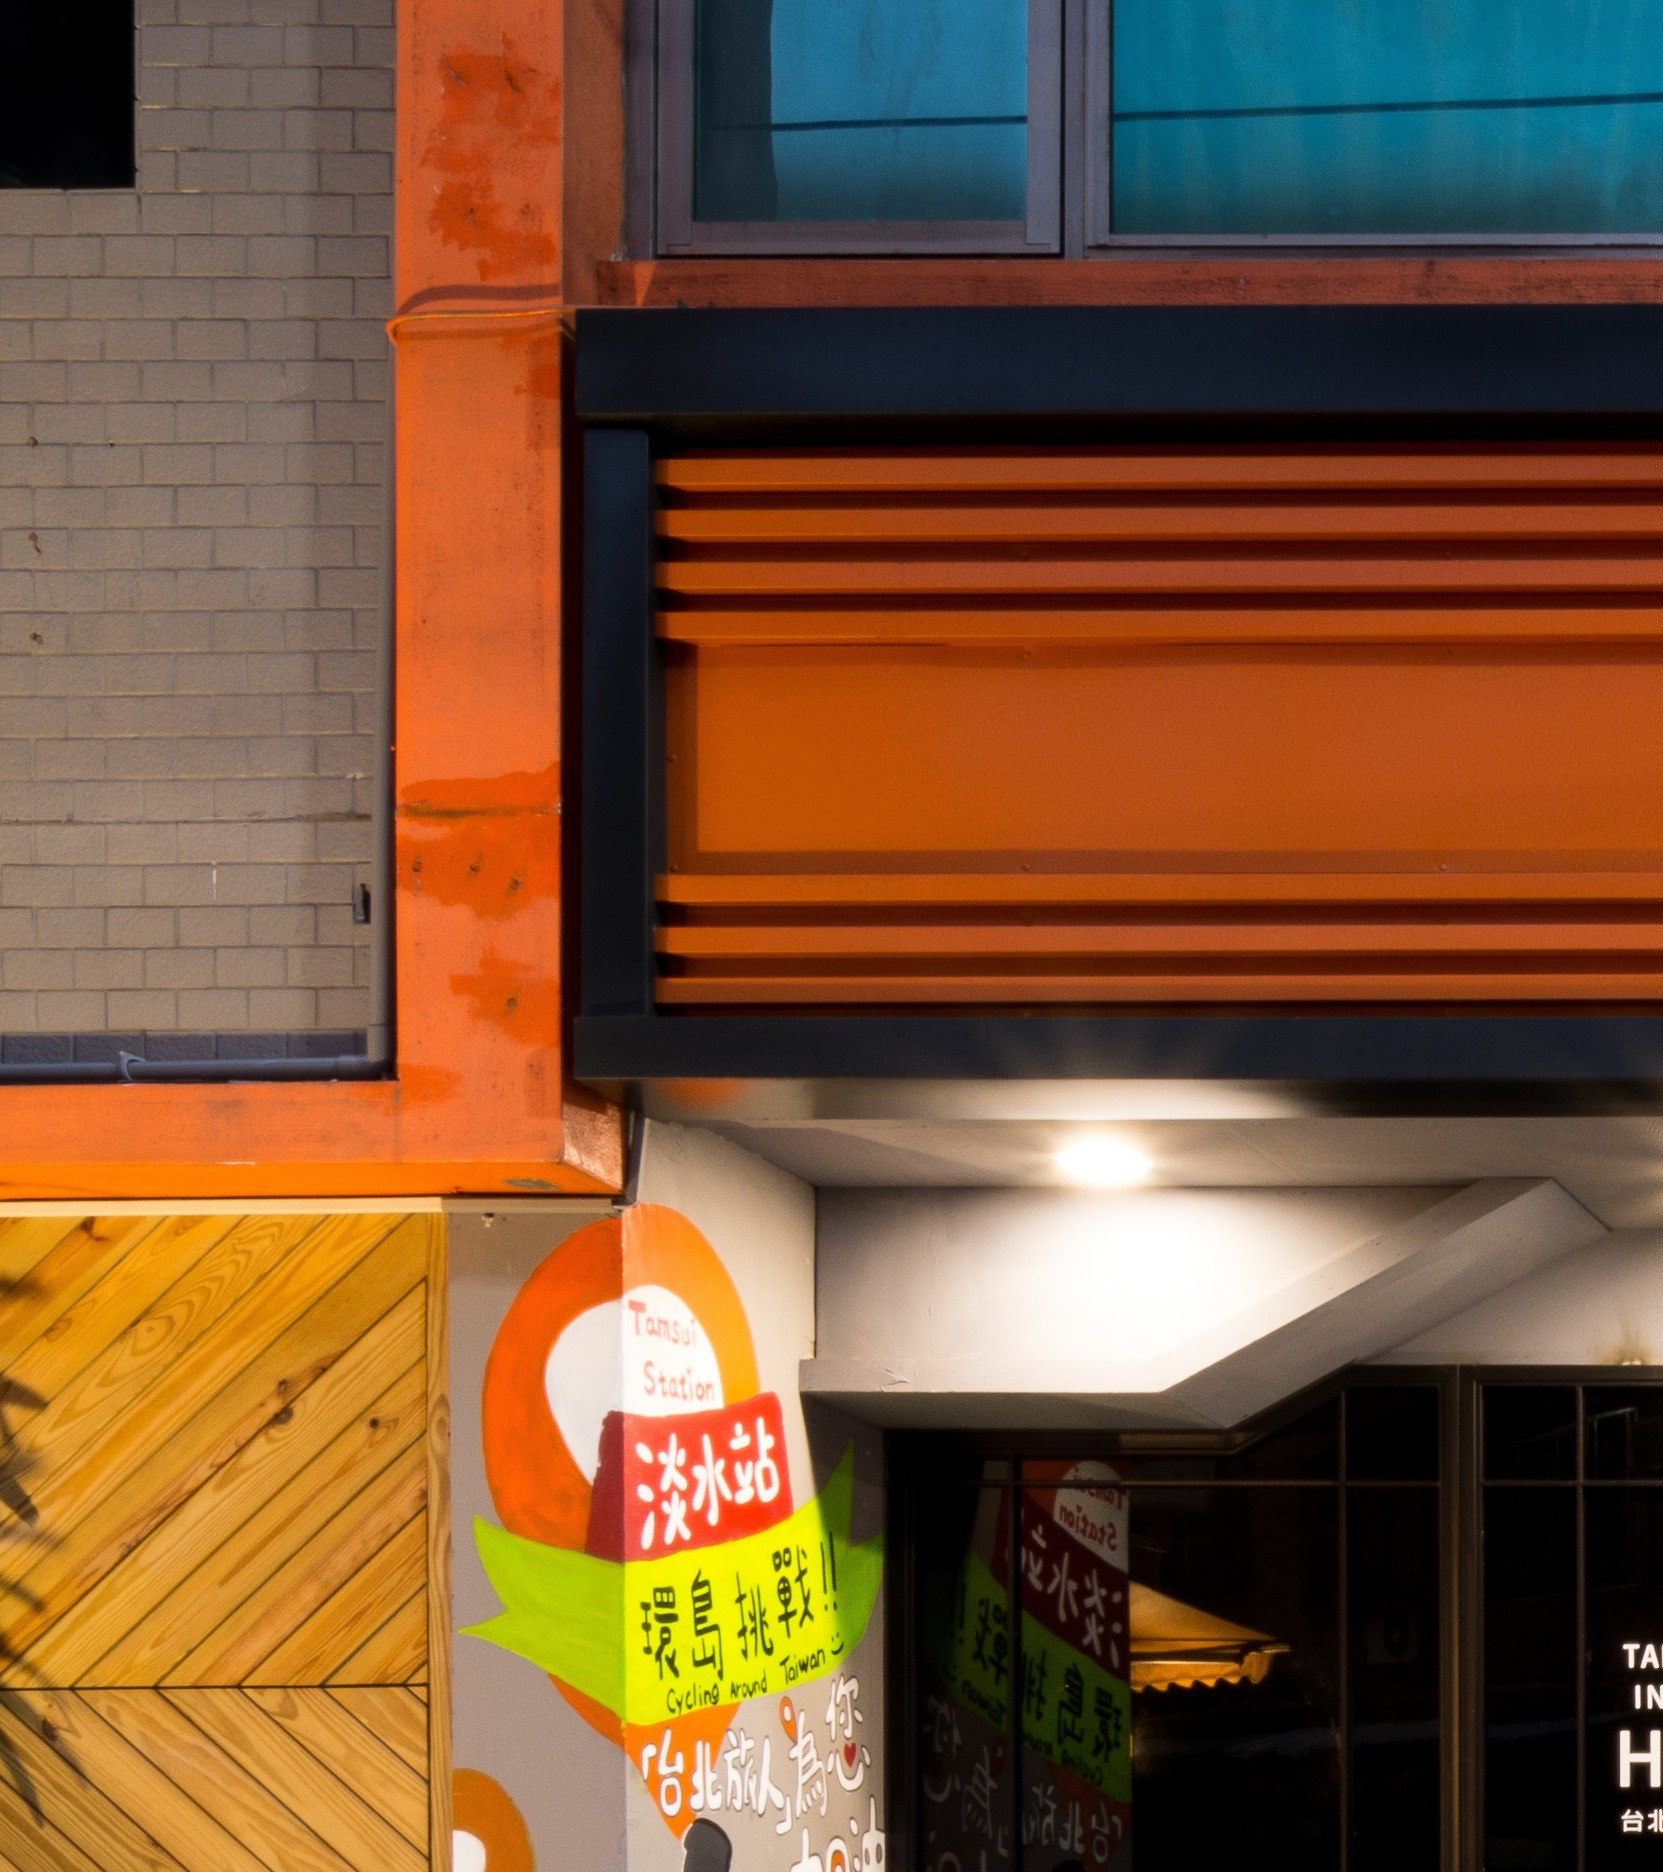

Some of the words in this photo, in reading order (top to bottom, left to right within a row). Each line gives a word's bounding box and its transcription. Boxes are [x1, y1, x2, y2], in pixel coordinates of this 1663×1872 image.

[628, 1299, 698, 1349] Tamsui
[643, 1360, 716, 1401] Station
[635, 1416, 780, 1550] 淡水站
[666, 1681, 720, 1716] Cycling
[730, 1668, 768, 1699] Around
[778, 1647, 826, 1685] Taiwan
